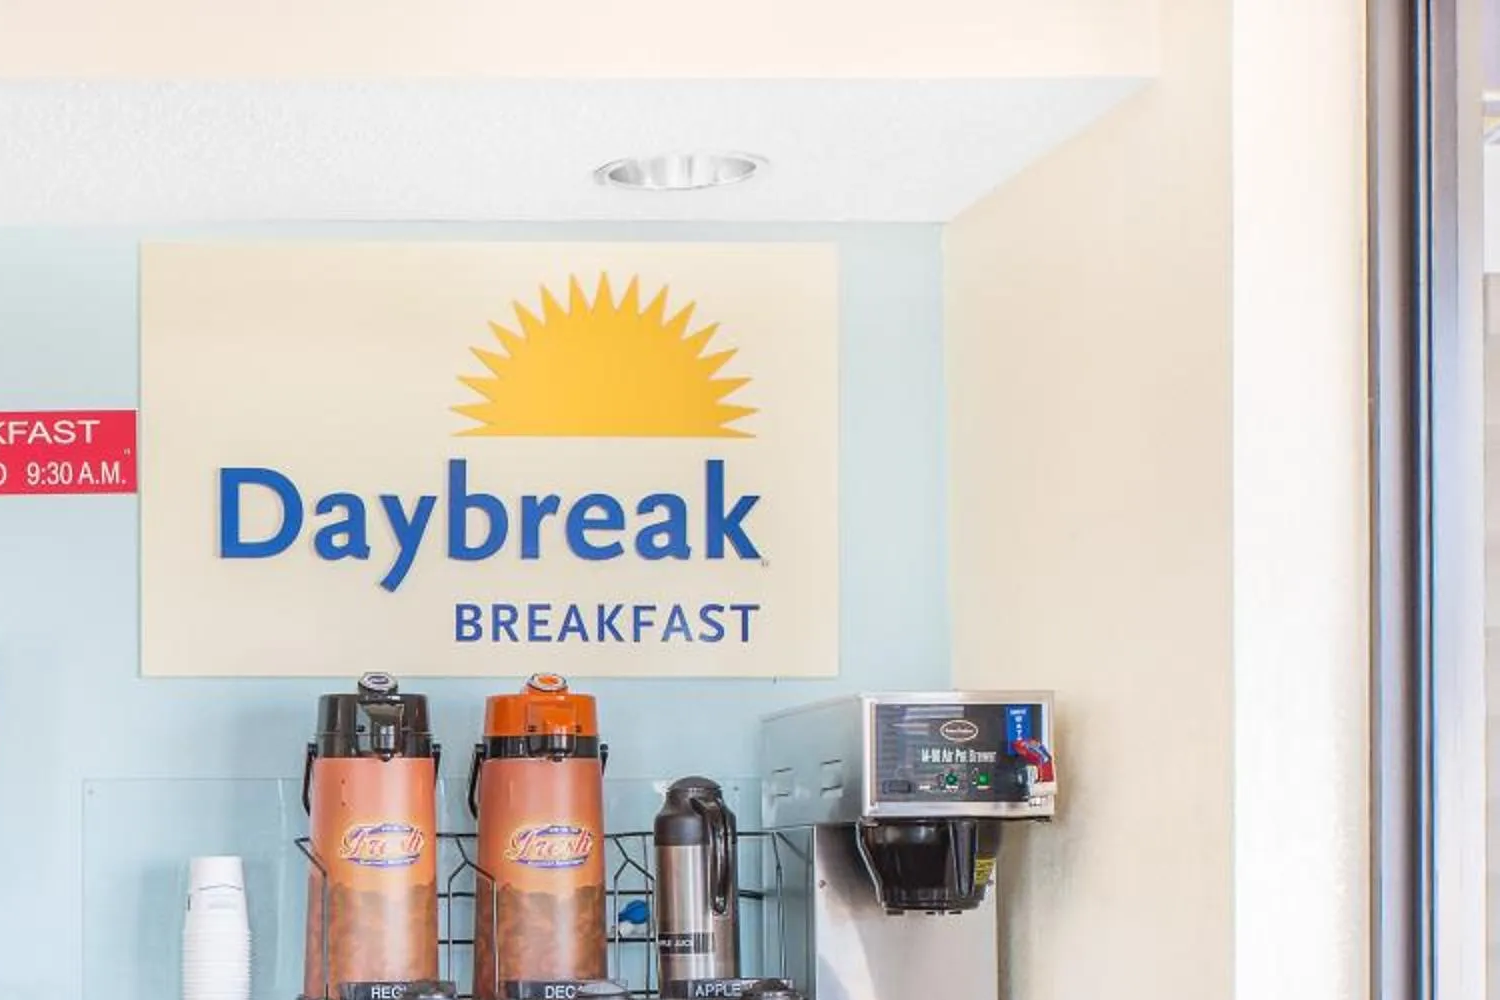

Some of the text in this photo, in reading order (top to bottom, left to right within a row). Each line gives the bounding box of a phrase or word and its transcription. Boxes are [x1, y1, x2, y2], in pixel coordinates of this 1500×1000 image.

[27, 462, 73, 485] 9:30
[77, 461, 126, 485] A.M.
[219, 458, 762, 593] Daybreak
[454, 603, 761, 643] BREAKFAST
[371, 985, 407, 999] REG
[545, 985, 582, 999] DEC
[695, 983, 741, 997] APPLE
